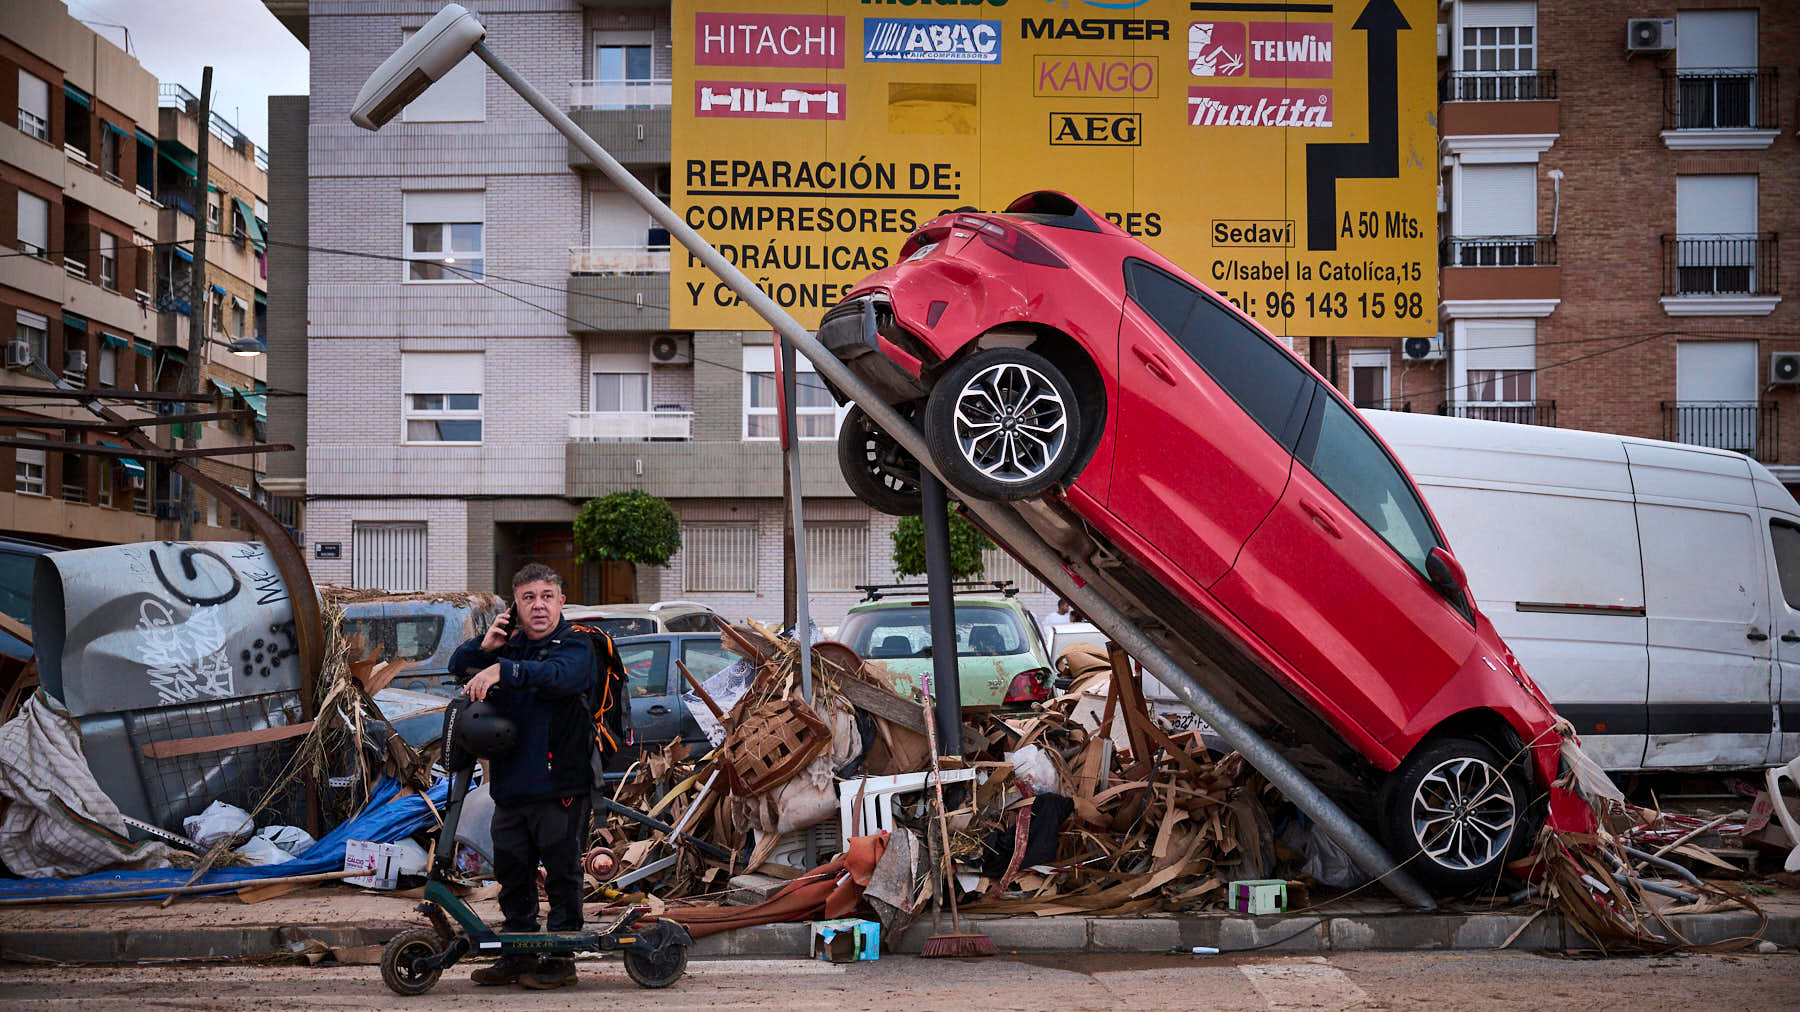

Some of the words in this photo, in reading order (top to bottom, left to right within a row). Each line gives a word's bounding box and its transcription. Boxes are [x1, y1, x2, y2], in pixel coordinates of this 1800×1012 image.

[704, 24, 836, 56] HITACHI
[905, 24, 997, 53] ABAC
[1021, 18, 1170, 40] MASTER
[1039, 61, 1154, 92] KANGO
[700, 87, 839, 114] HILTI
[1055, 117, 1137, 142] AEG
[686, 155, 896, 191] REPARACIÓN
[909, 163, 961, 191] DE:
[685, 205, 917, 233] COMPRESORES
[1214, 222, 1292, 244] Sedaví
[1340, 210, 1354, 239] A
[1358, 211, 1379, 239] 50
[1385, 211, 1424, 239] Mts.
[688, 239, 889, 271] HDRÁULICAS
[1211, 260, 1290, 281] C/Isabel
[1296, 260, 1312, 281] la
[686, 282, 705, 306] Y
[713, 277, 854, 308] CÑONE
[1266, 291, 1295, 319] 96
[1305, 292, 1348, 319] 143
[1358, 292, 1386, 319] 15
[1393, 292, 1423, 319] 98
